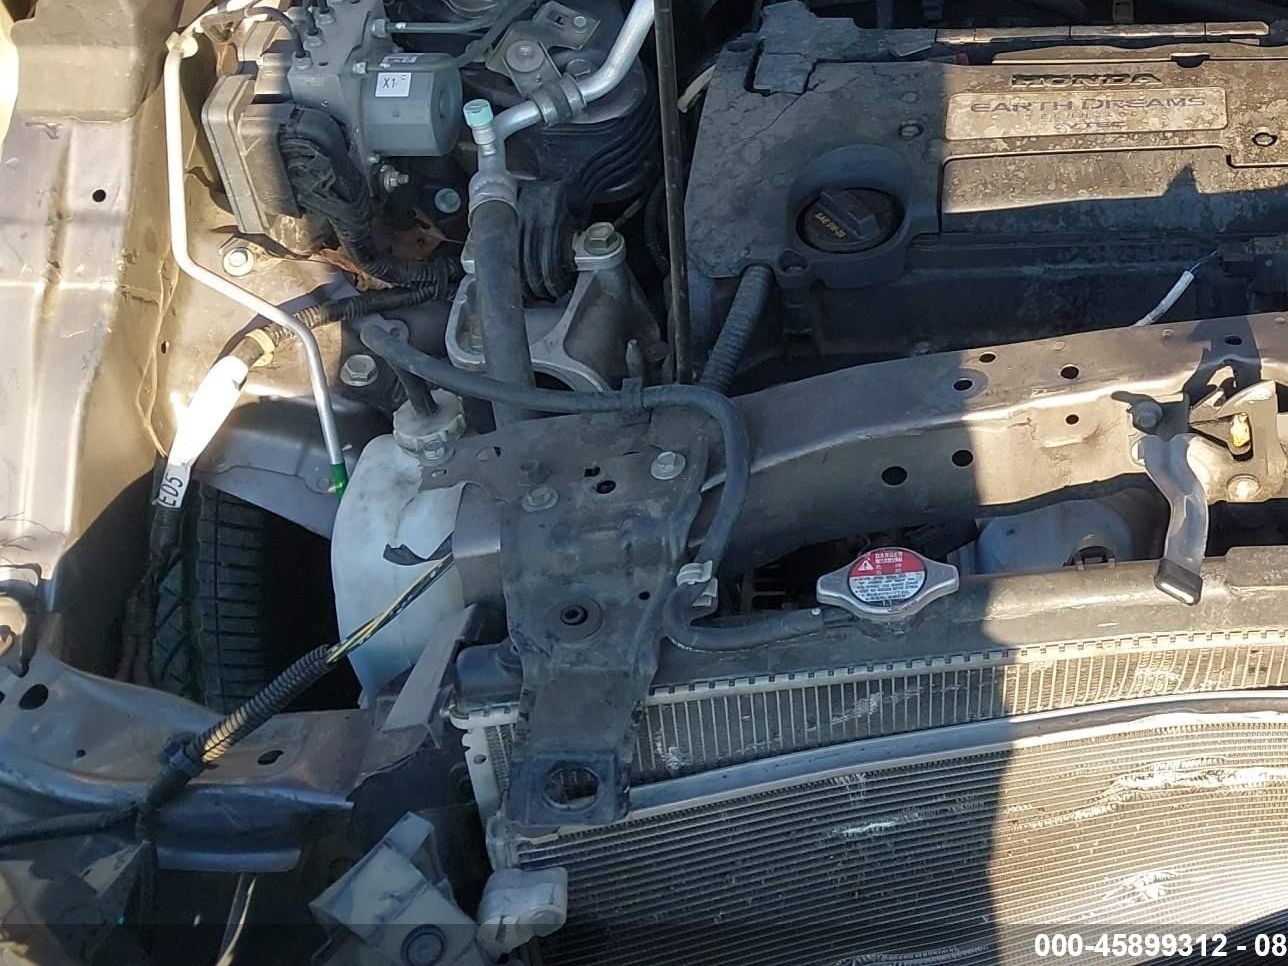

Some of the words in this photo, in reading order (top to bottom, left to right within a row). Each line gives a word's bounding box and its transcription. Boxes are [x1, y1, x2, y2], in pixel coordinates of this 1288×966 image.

[1010, 73, 1162, 87] HONDA
[970, 101, 1074, 113] EARTH
[1079, 97, 1206, 111] DREAMS
[158, 472, 183, 506] E05
